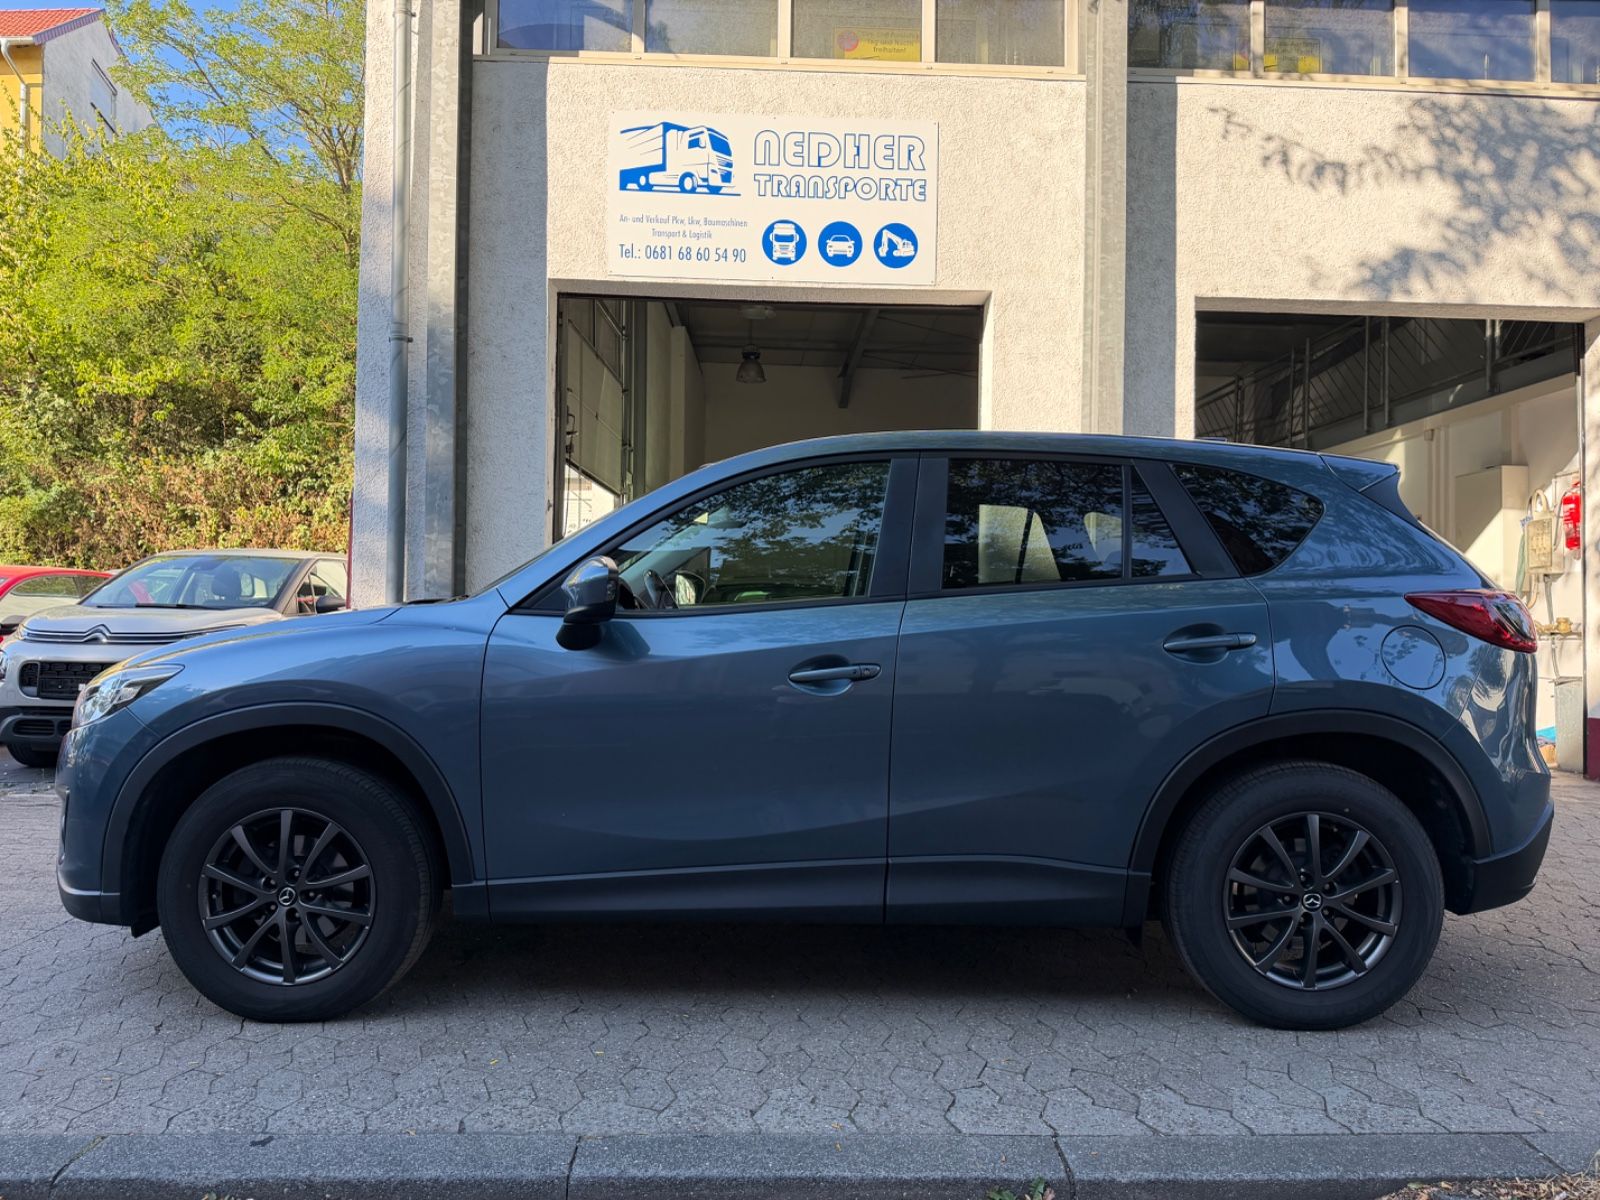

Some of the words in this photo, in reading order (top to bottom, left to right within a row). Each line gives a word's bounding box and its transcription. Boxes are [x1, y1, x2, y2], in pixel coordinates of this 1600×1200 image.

[754, 130, 926, 171] NEDHER
[754, 173, 927, 202] TRANSPORTE
[619, 214, 631, 223] An-
[632, 213, 644, 224] und
[645, 214, 670, 224] Verkauf
[671, 215, 686, 226] Pkw,
[688, 216, 702, 226] Lkw,
[704, 217, 748, 228] Baumaschinen
[652, 228, 681, 239] Transport
[682, 229, 688, 238] &
[689, 230, 713, 240] Logistik
[619, 243, 641, 259] Tel.:
[645, 244, 672, 260] 0681
[678, 246, 692, 261] 68
[696, 247, 710, 262] 60
[714, 247, 728, 262] 54
[732, 248, 746, 263] 90
